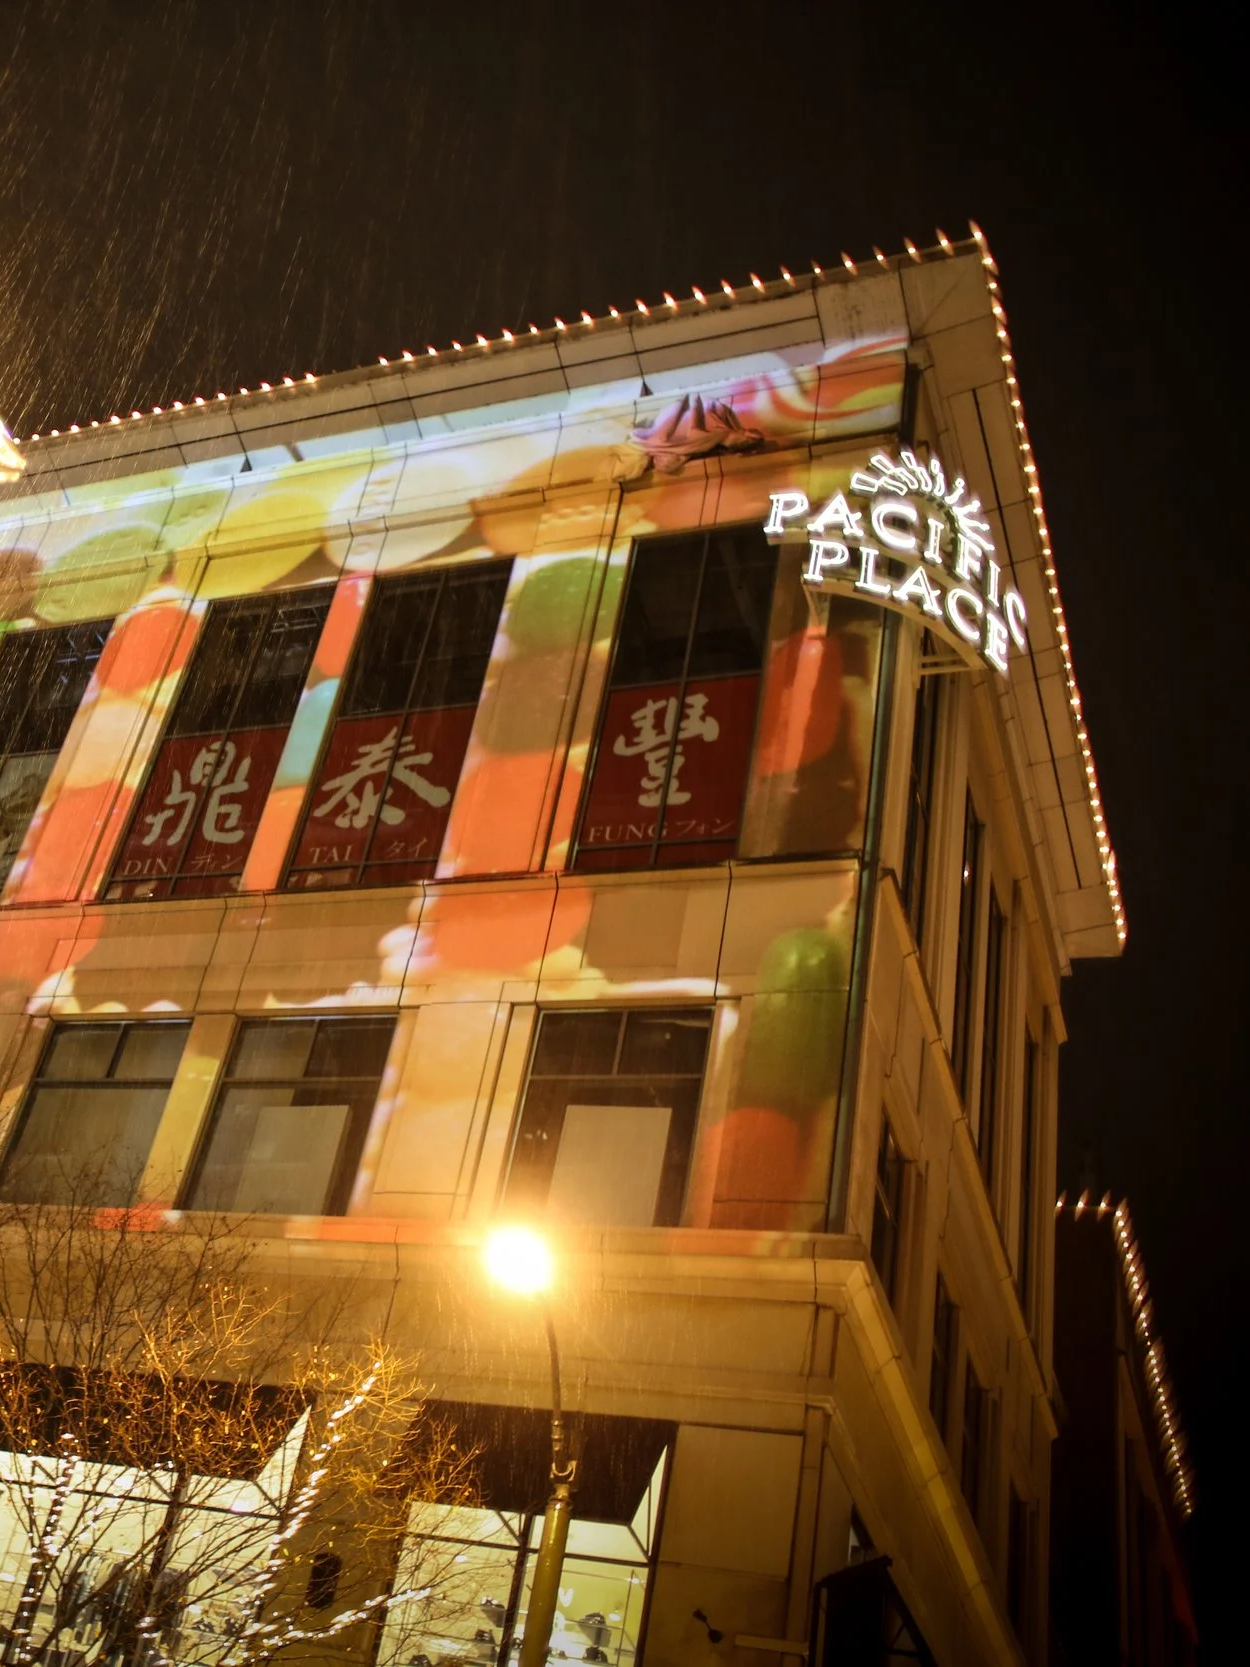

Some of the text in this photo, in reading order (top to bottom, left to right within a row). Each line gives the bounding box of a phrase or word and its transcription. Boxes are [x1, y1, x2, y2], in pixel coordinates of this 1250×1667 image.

[763, 490, 1027, 648] PACIFIC
[803, 538, 1009, 672] PLACE
[313, 725, 452, 830] 泰
[309, 844, 354, 864] TAI
[588, 822, 670, 843] FUNG
[123, 856, 173, 876] DIN
